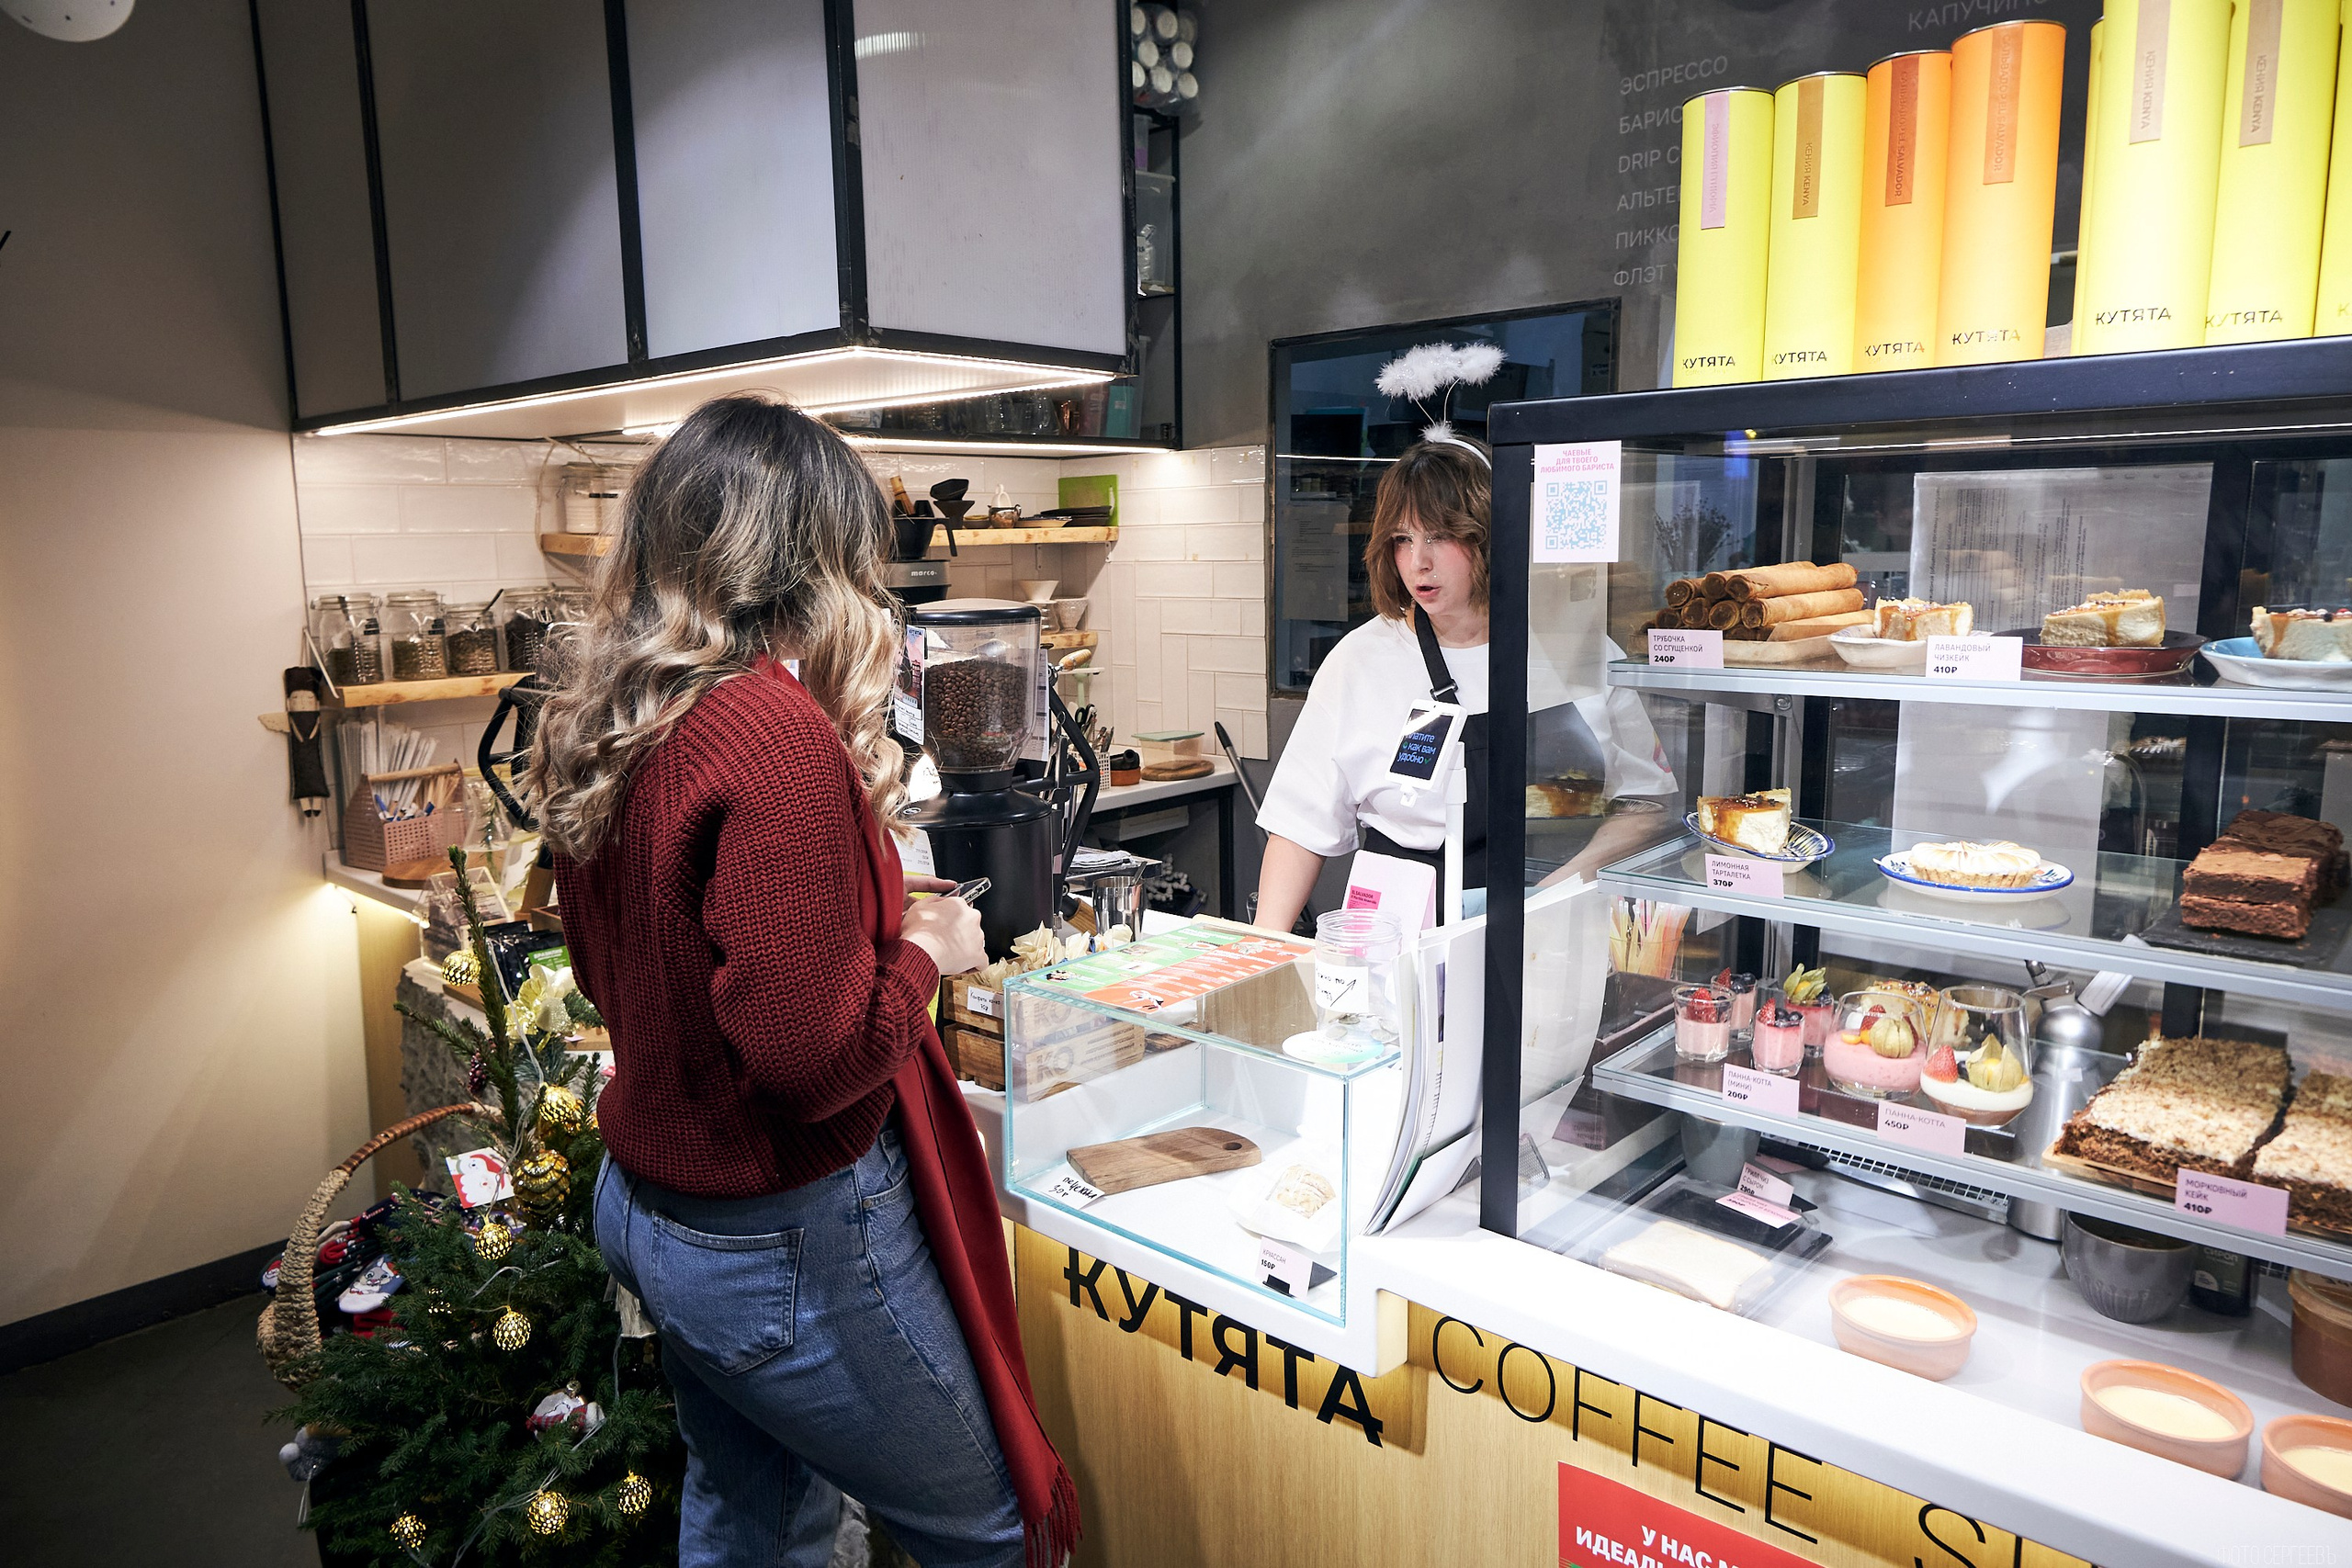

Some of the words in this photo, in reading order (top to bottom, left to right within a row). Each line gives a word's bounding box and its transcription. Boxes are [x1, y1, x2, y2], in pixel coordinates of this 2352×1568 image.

[1908, 0, 2046, 32] КАПУЧИ
[1620, 55, 1728, 96] ЭСПРЕССО
[2143, 51, 2155, 90] КЕНИЯ
[2254, 54, 2267, 93] КЕНИЯ
[2141, 91, 2153, 130] KENYA
[2251, 95, 2264, 133] KENYA
[1994, 116, 2006, 172] SALVADOR
[1618, 149, 1661, 174] DRIP
[1804, 141, 1813, 175] КЕНИЯ
[1894, 146, 1905, 197] SALVADOR
[1617, 186, 1681, 212] АЛЬТЕ
[1802, 175, 1811, 207] KENYA
[1613, 264, 1668, 287] ФЛЭТ
[2096, 307, 2172, 326] КУТЯТА
[2204, 310, 2283, 330] КУТЯТА
[1951, 329, 2020, 345] КУТЯТА
[1770, 351, 1828, 366] КУТЯТА
[1864, 341, 1926, 357] КУТЯТА
[1682, 355, 1736, 369] КУТЯТА
[1555, 457, 1571, 466] ДЛЯ
[1572, 456, 1599, 465] ТВОЕГО
[1562, 448, 1591, 457] ЧАЕВЫЕ
[1540, 465, 1580, 474] ЛЮБИМОГО
[1581, 463, 1614, 472] БАРИСТА
[1663, 644, 1703, 653] СГУЩЕНКОЙ
[1934, 643, 1991, 652] ЛАВАНДОВЫЙ
[1934, 652, 1970, 661] ЧИЗКЕЙК
[1406, 732, 1435, 743] латите
[1396, 752, 1424, 764] удобно
[1408, 742, 1421, 752] как
[1421, 745, 1437, 755] вам
[1712, 860, 1749, 872] ЛИМОННАЯ
[1712, 869, 1751, 881] ТАРТАЛЕТКА
[1727, 1079, 1752, 1092] (МИНИ)
[1728, 1070, 1772, 1088] ПАННА-КОТТА
[1884, 1108, 1946, 1129] ПАННА-КОТТА
[2185, 1179, 2248, 1200] МОРКОВНЫЙ
[2185, 1190, 2210, 1201] КЕЙК
[1261, 1248, 1287, 1265] КРУАССАН
[1064, 1246, 1384, 1449] КУТЯТА
[1432, 1314, 1823, 1545] COFFEE
[1576, 1526, 1664, 1568] ИДЕАЛ
[1641, 1525, 1657, 1547] У
[1661, 1534, 1713, 1568] НАС
